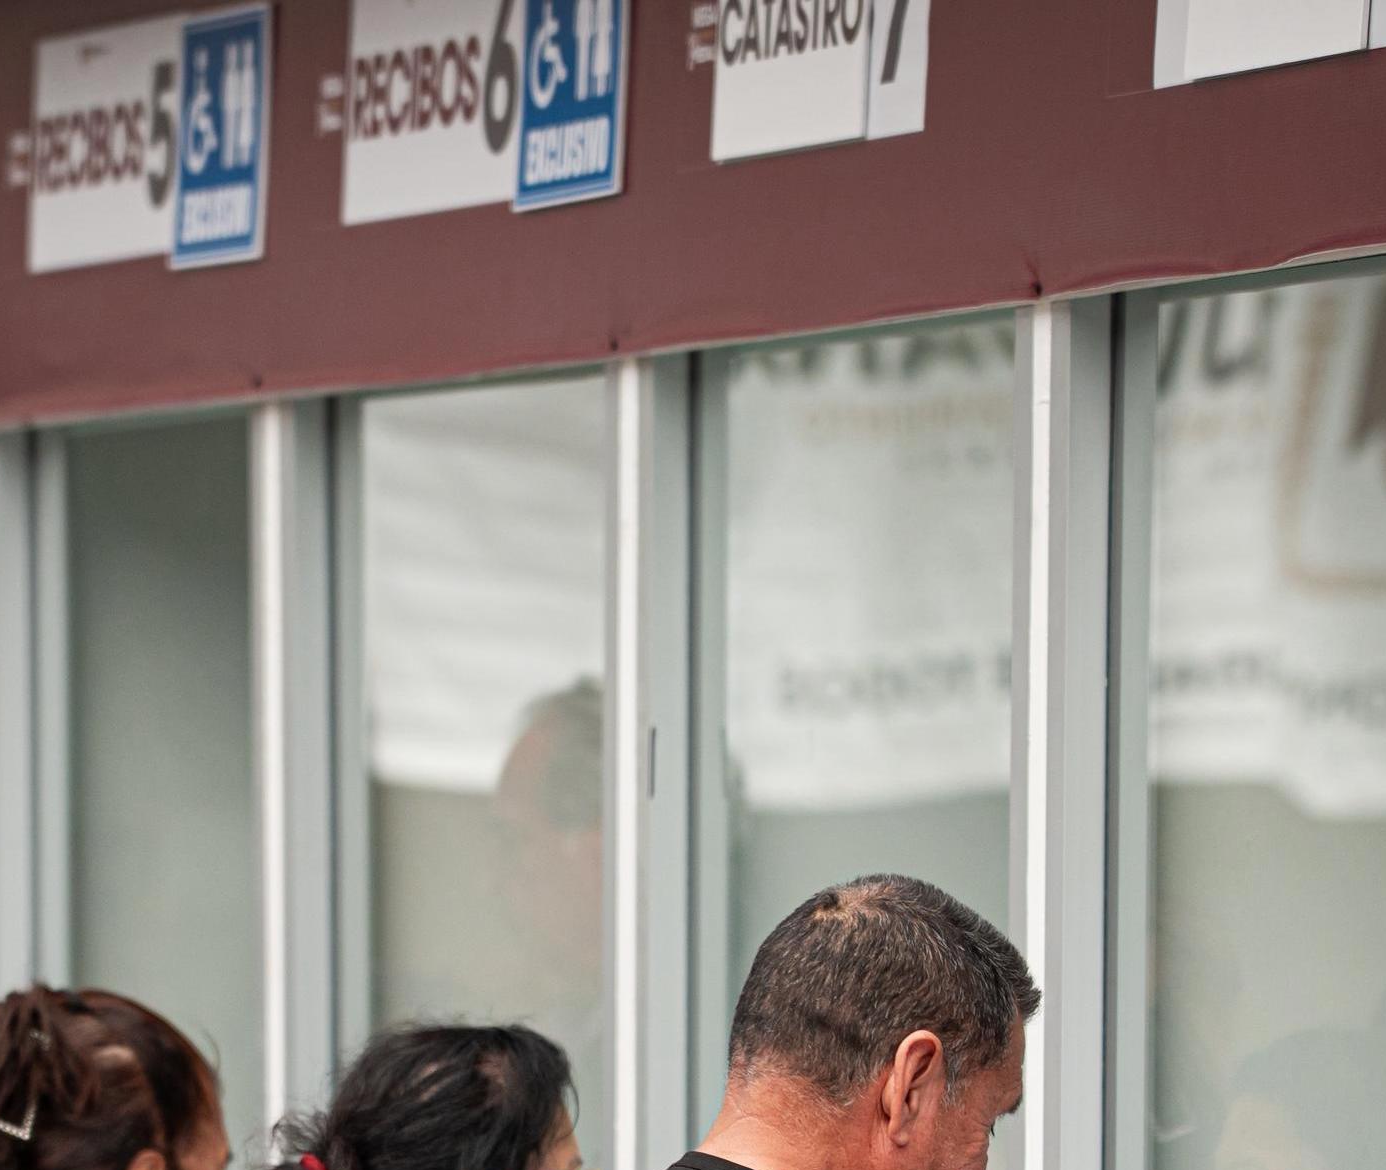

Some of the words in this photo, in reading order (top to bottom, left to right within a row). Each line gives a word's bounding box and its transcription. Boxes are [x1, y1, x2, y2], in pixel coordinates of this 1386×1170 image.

[352, 36, 482, 140] RECIBOS
[483, 0, 519, 155] 6
[720, 0, 863, 66] CATASTRO
[147, 60, 176, 208] 5
[523, 116, 611, 187] EXCLUSIVO
